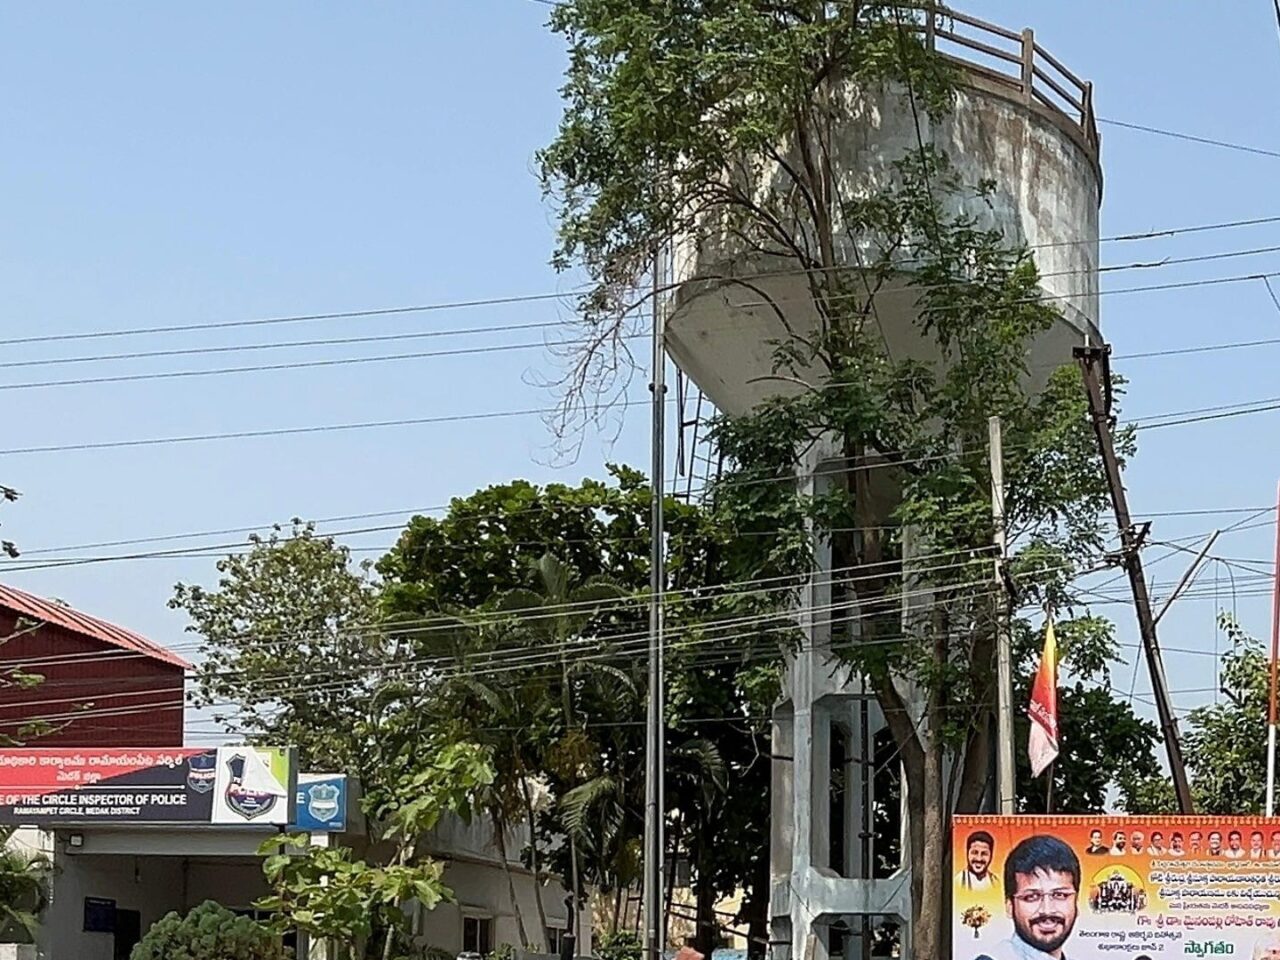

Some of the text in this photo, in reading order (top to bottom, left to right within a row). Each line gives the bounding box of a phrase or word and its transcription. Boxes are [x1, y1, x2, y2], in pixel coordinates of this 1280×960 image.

[6, 794, 20, 805] OF
[21, 794, 41, 805] THE
[42, 794, 77, 805] CIRCLE
[78, 794, 134, 805] INSPECTOR
[135, 794, 149, 805] OF
[151, 794, 187, 805] POLICE
[110, 807, 140, 815] DISTRICT
[1255, 916, 1276, 929] రావు
[1184, 940, 1234, 957] స్వాగతం
